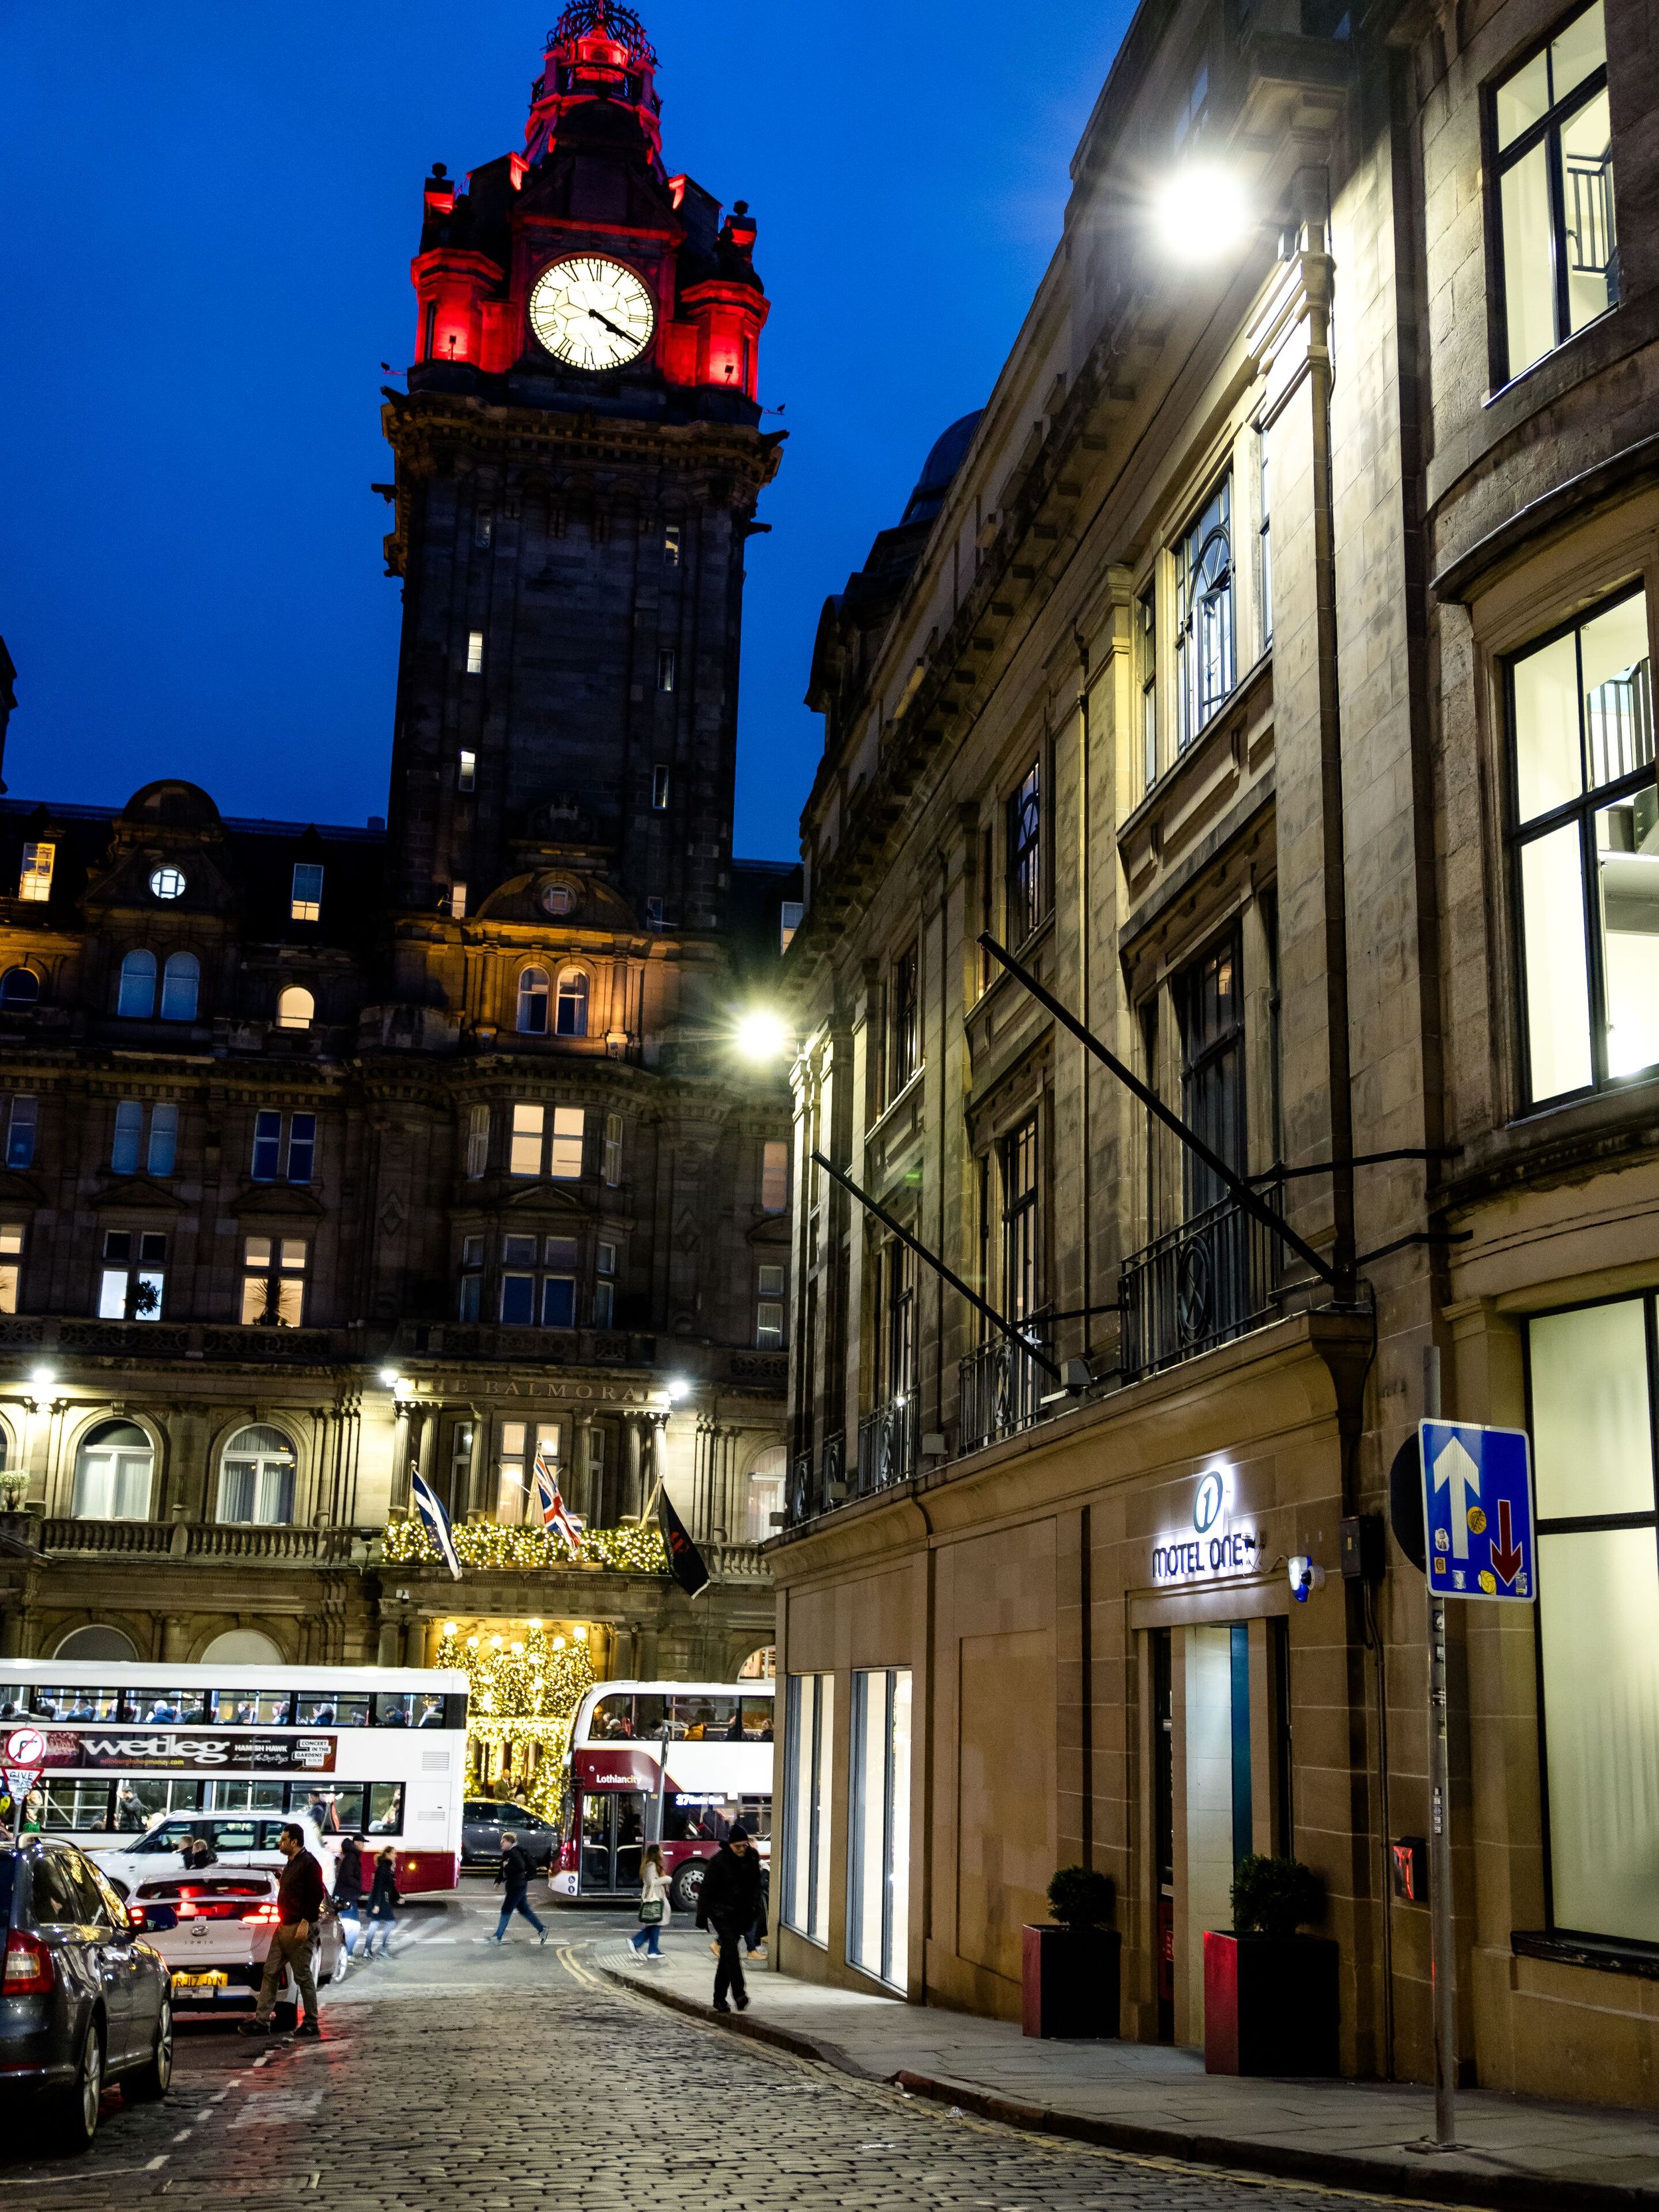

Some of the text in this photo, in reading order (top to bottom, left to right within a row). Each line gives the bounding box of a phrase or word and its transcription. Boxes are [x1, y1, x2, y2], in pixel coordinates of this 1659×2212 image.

[1153, 1533, 1244, 1578] MOTEL ONE
[10, 1771, 33, 1780] GIVE
